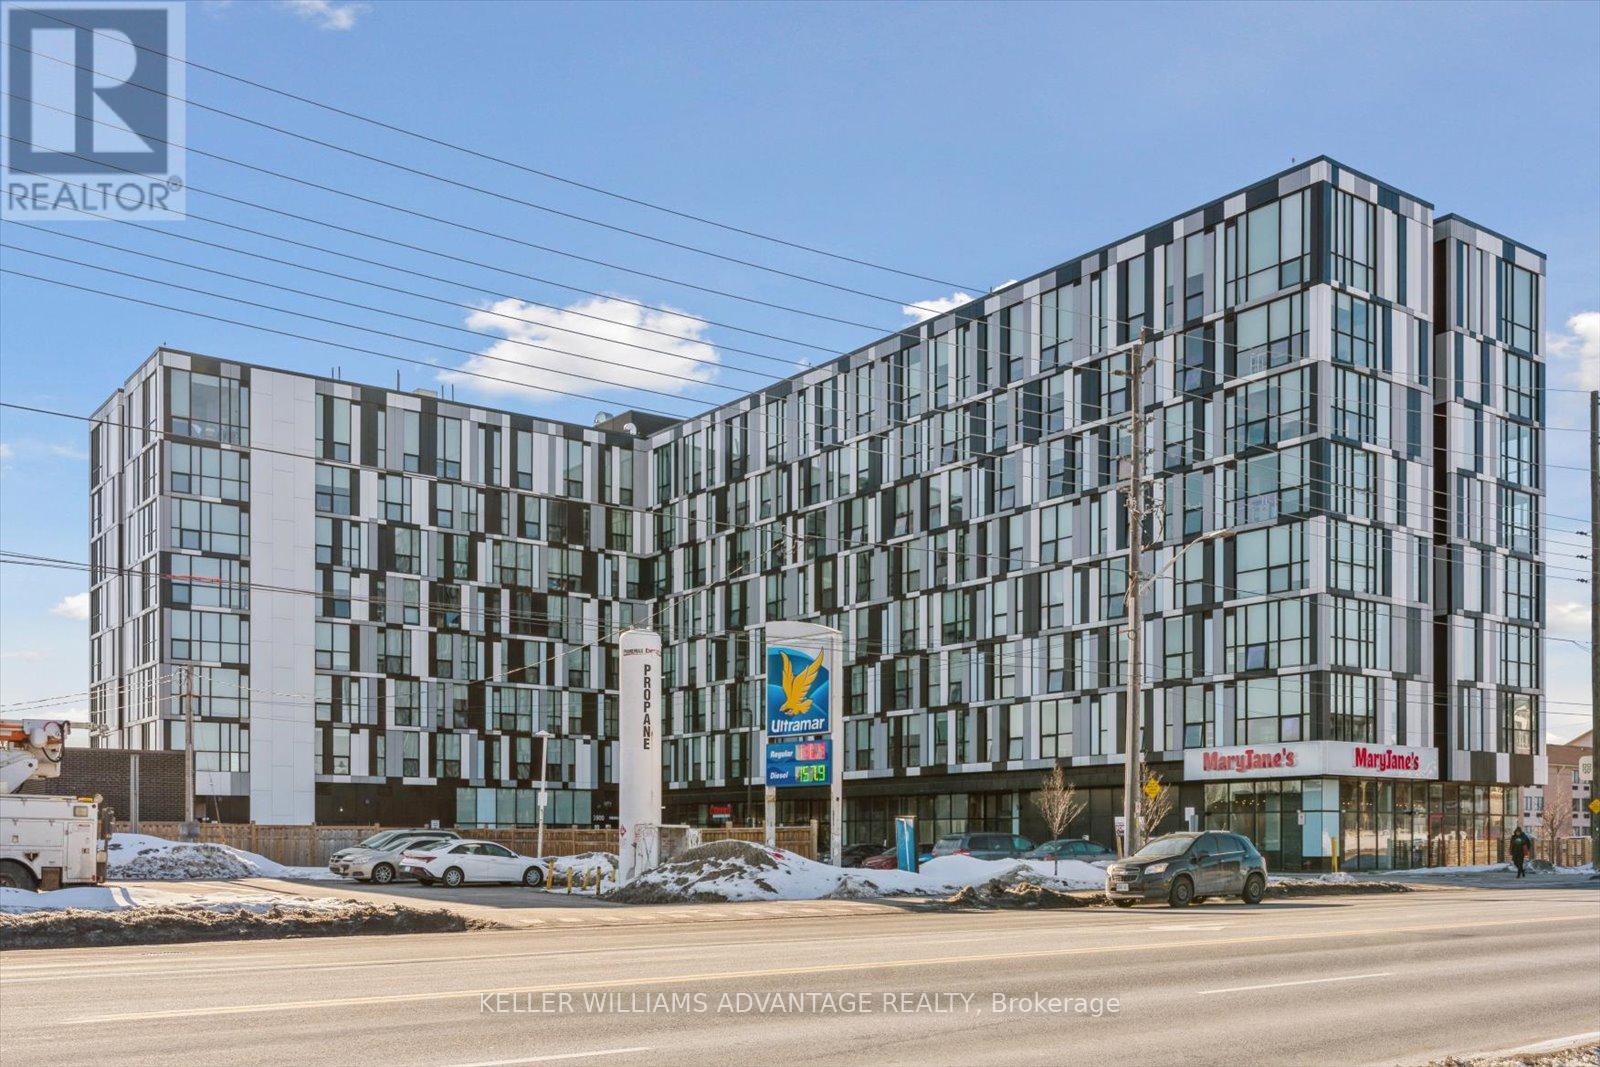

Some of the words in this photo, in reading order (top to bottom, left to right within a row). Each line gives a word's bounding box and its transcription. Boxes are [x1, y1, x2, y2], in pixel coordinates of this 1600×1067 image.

[643, 664, 652, 750] PROPANE
[771, 718, 826, 733] Ultramar
[770, 750, 793, 759] Regular
[1203, 748, 1295, 772] MaryJane's
[1355, 747, 1420, 772] MaryJane's
[770, 771, 789, 779] Diesel
